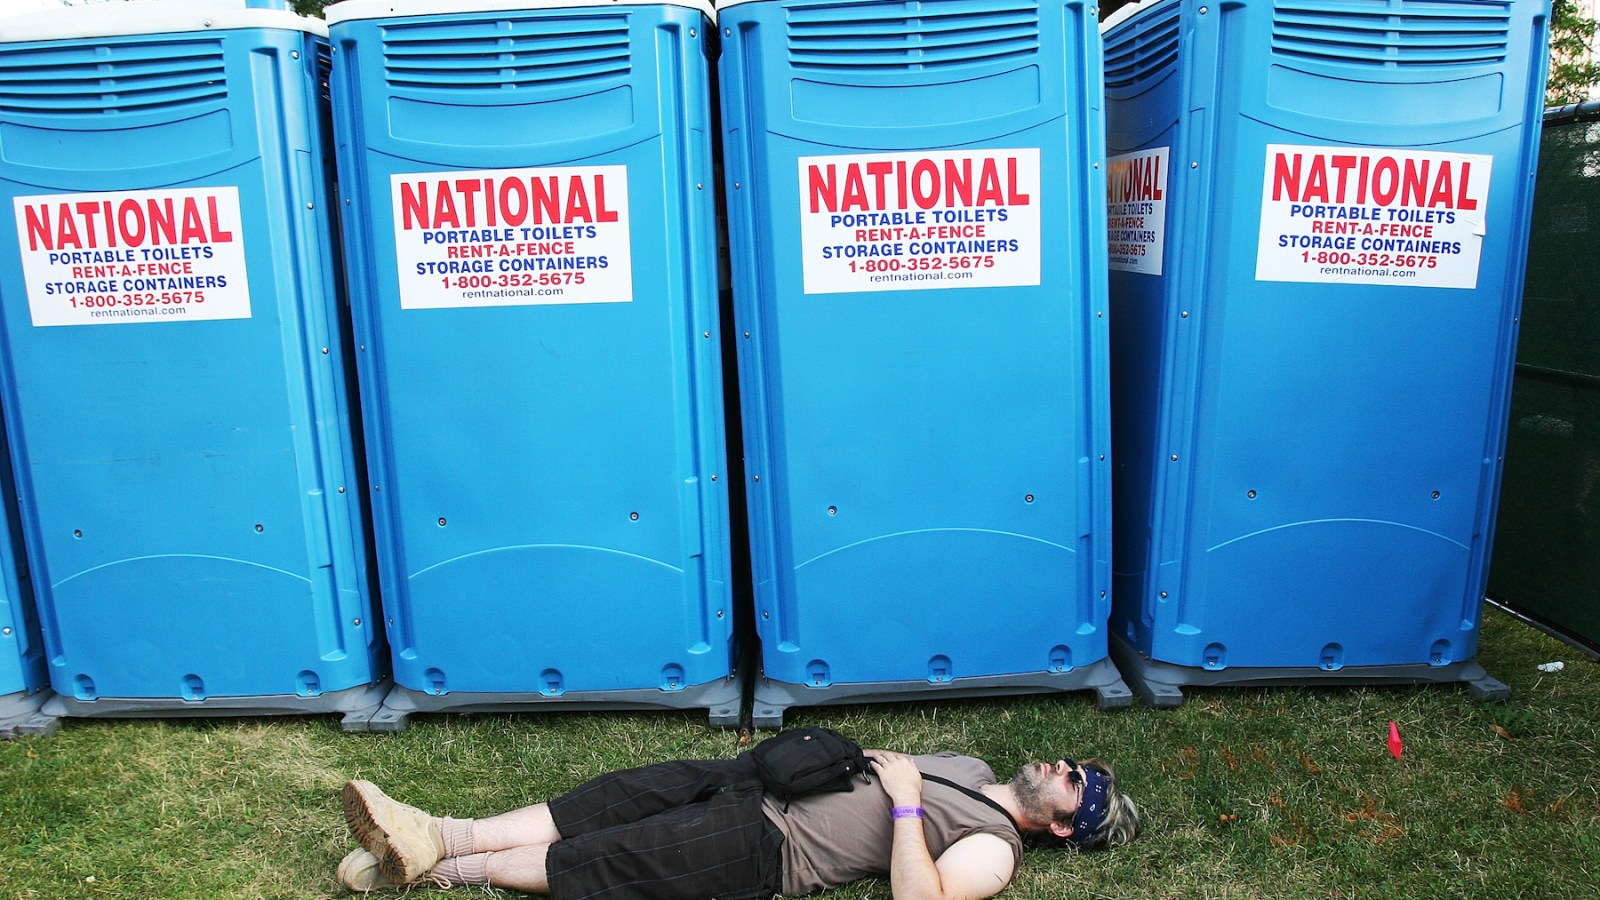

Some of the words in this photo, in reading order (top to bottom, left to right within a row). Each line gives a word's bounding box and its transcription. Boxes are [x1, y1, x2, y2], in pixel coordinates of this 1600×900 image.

[808, 158, 1029, 213] NATIONAL
[1107, 156, 1162, 203] ATIONAL
[1272, 153, 1477, 210] NATIONAL
[400, 175, 618, 230] NATIONAL
[1128, 203, 1153, 215] TOILETS
[831, 212, 925, 227] PORTABLE
[932, 209, 1008, 224] TOILETS
[1291, 205, 1381, 221] PORTABLE
[1387, 208, 1455, 224] TOILETS
[24, 196, 233, 251] NATIONAL
[1312, 221, 1433, 238] RENT-A-FENCE
[423, 229, 514, 244] PORTABLE
[521, 226, 597, 241] TOILETS
[856, 225, 985, 242] RENT-A-FENCE
[1121, 231, 1156, 243] CONTAINERS
[448, 242, 574, 258] RENT-A-FENCE
[822, 243, 903, 259] STORAGE
[909, 239, 1018, 255] CONTAINERS
[1279, 235, 1355, 249] STORAGE
[1361, 238, 1461, 254] CONTAINERS
[49, 249, 135, 265] PORTABLE
[141, 246, 213, 261] TOILETS
[848, 256, 994, 272] 1-800-352-5675
[1301, 251, 1437, 268] 1-800-352-5675
[72, 262, 193, 278] RENT-A-FENCE
[416, 260, 493, 275] STORAGE
[500, 256, 608, 272] CONTAINERS
[1320, 266, 1416, 278] rentnational.com
[46, 280, 117, 294] STORAGE
[123, 275, 227, 292] CONTAINERS
[442, 272, 585, 289] 1-800-352-5675
[870, 271, 972, 282] rentnational.com
[69, 291, 205, 308] 1-800-352-5675
[462, 288, 563, 298] rentnational.com
[91, 306, 186, 318] rentnational.com
